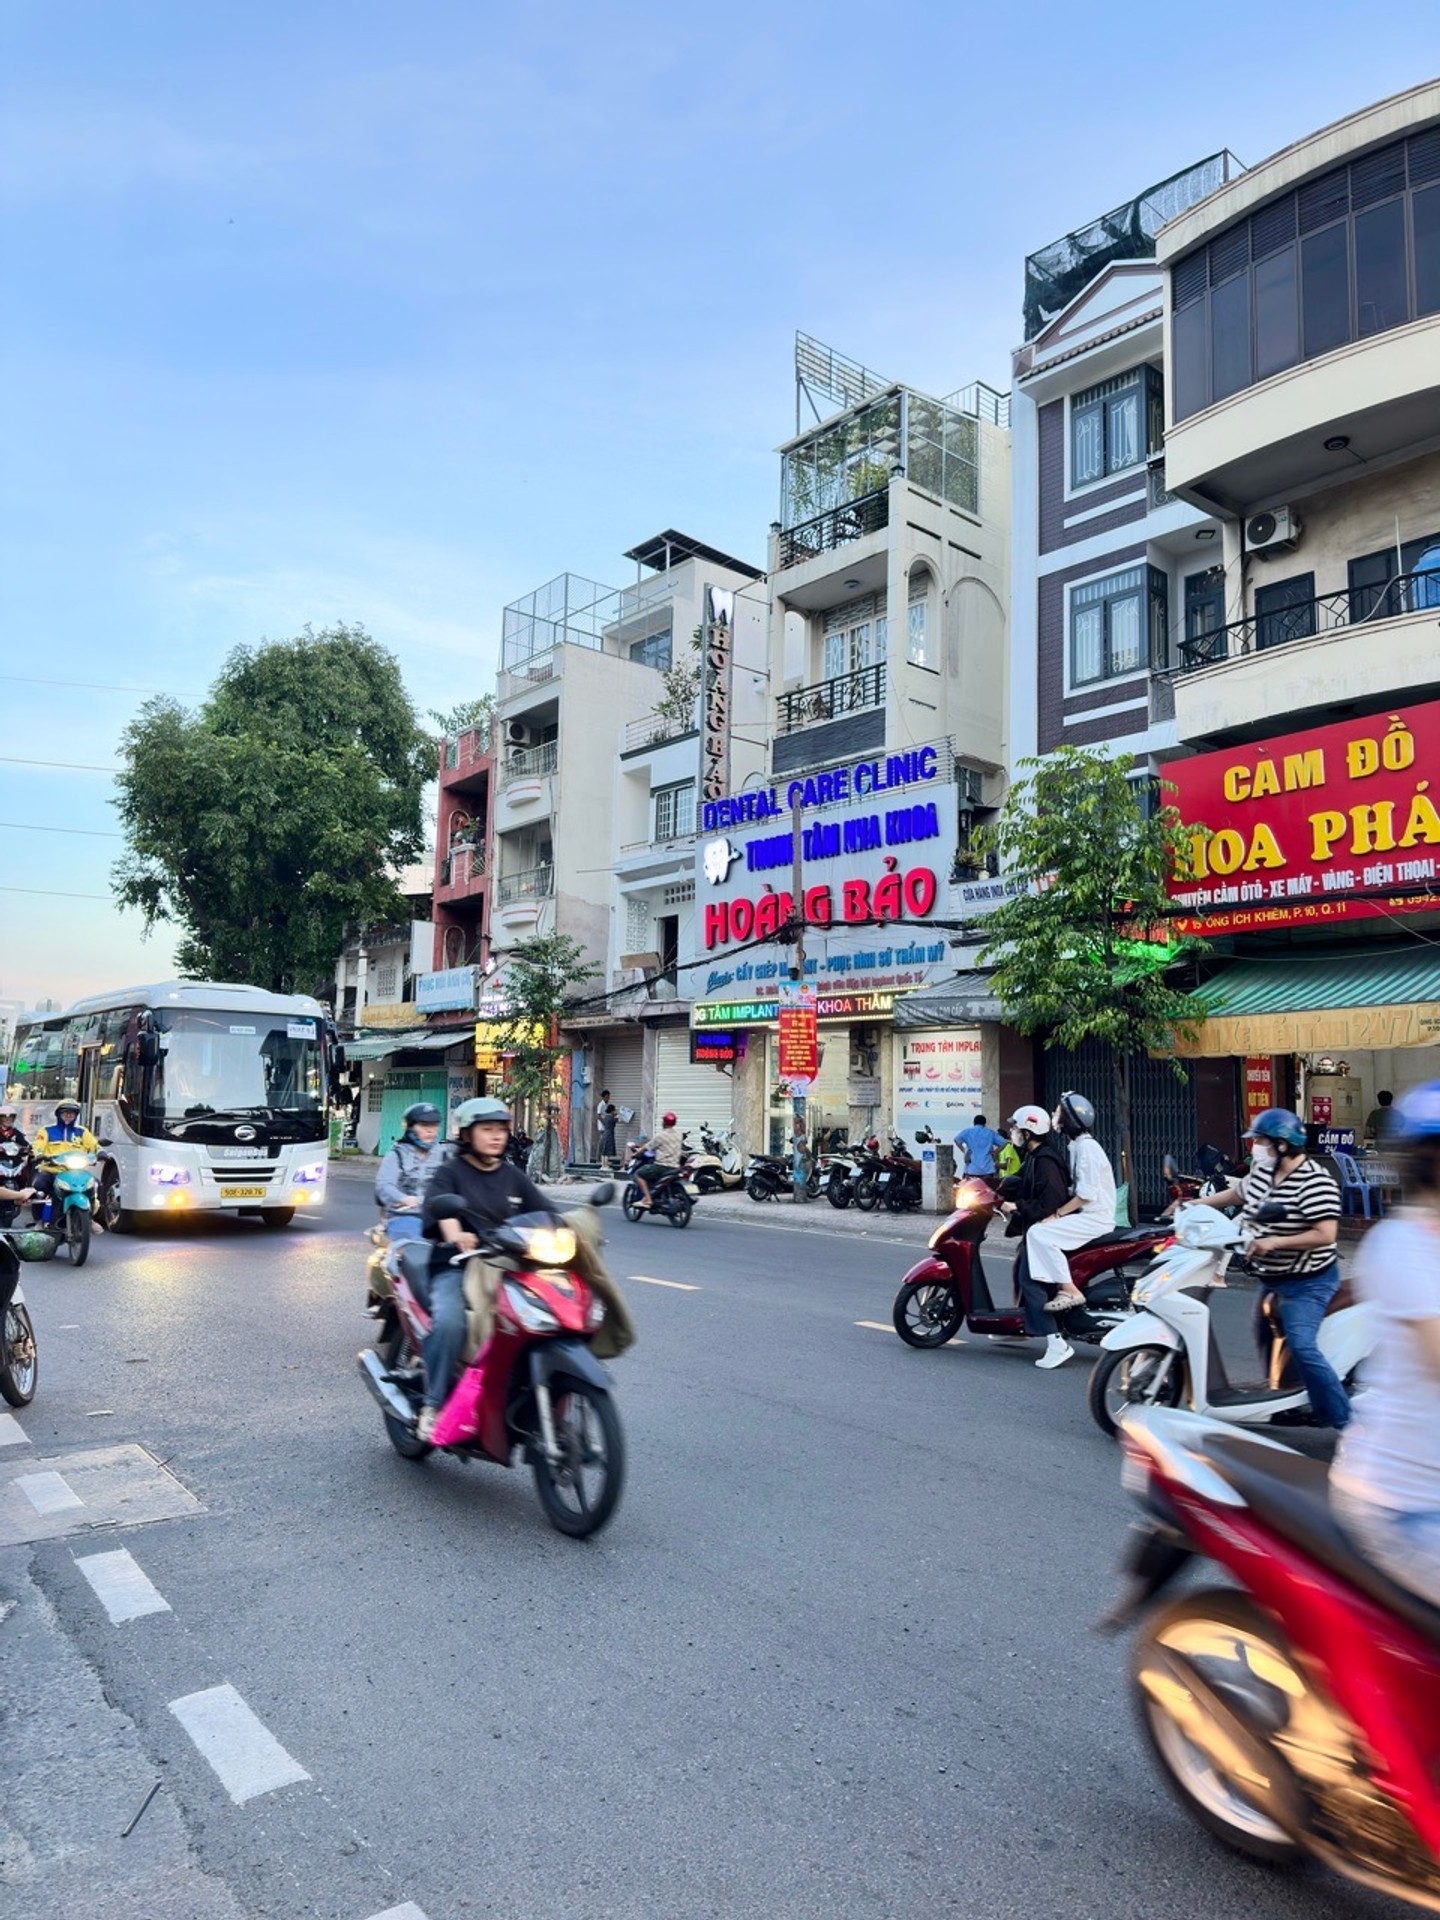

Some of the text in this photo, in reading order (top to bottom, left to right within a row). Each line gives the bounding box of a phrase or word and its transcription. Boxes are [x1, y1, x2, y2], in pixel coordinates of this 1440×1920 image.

[1346, 714, 1415, 779] ĐỒ
[703, 746, 938, 831] DENTAL CARE CLINIC
[802, 821, 841, 862] TÂM
[843, 815, 882, 855] NHA
[885, 802, 939, 847] KHOA
[1172, 823, 1287, 882] HOA
[843, 856, 937, 925] BẢO
[1270, 879, 1285, 898] XE
[1287, 873, 1312, 896] MÁY
[1322, 869, 1355, 891] VÀNG
[1363, 861, 1393, 887] ĐIỆN
[1396, 858, 1435, 882] THOẠI
[708, 1004, 730, 1020] TÂM
[732, 1003, 779, 1019] IMPLANT
[817, 998, 852, 1014] KHOA
